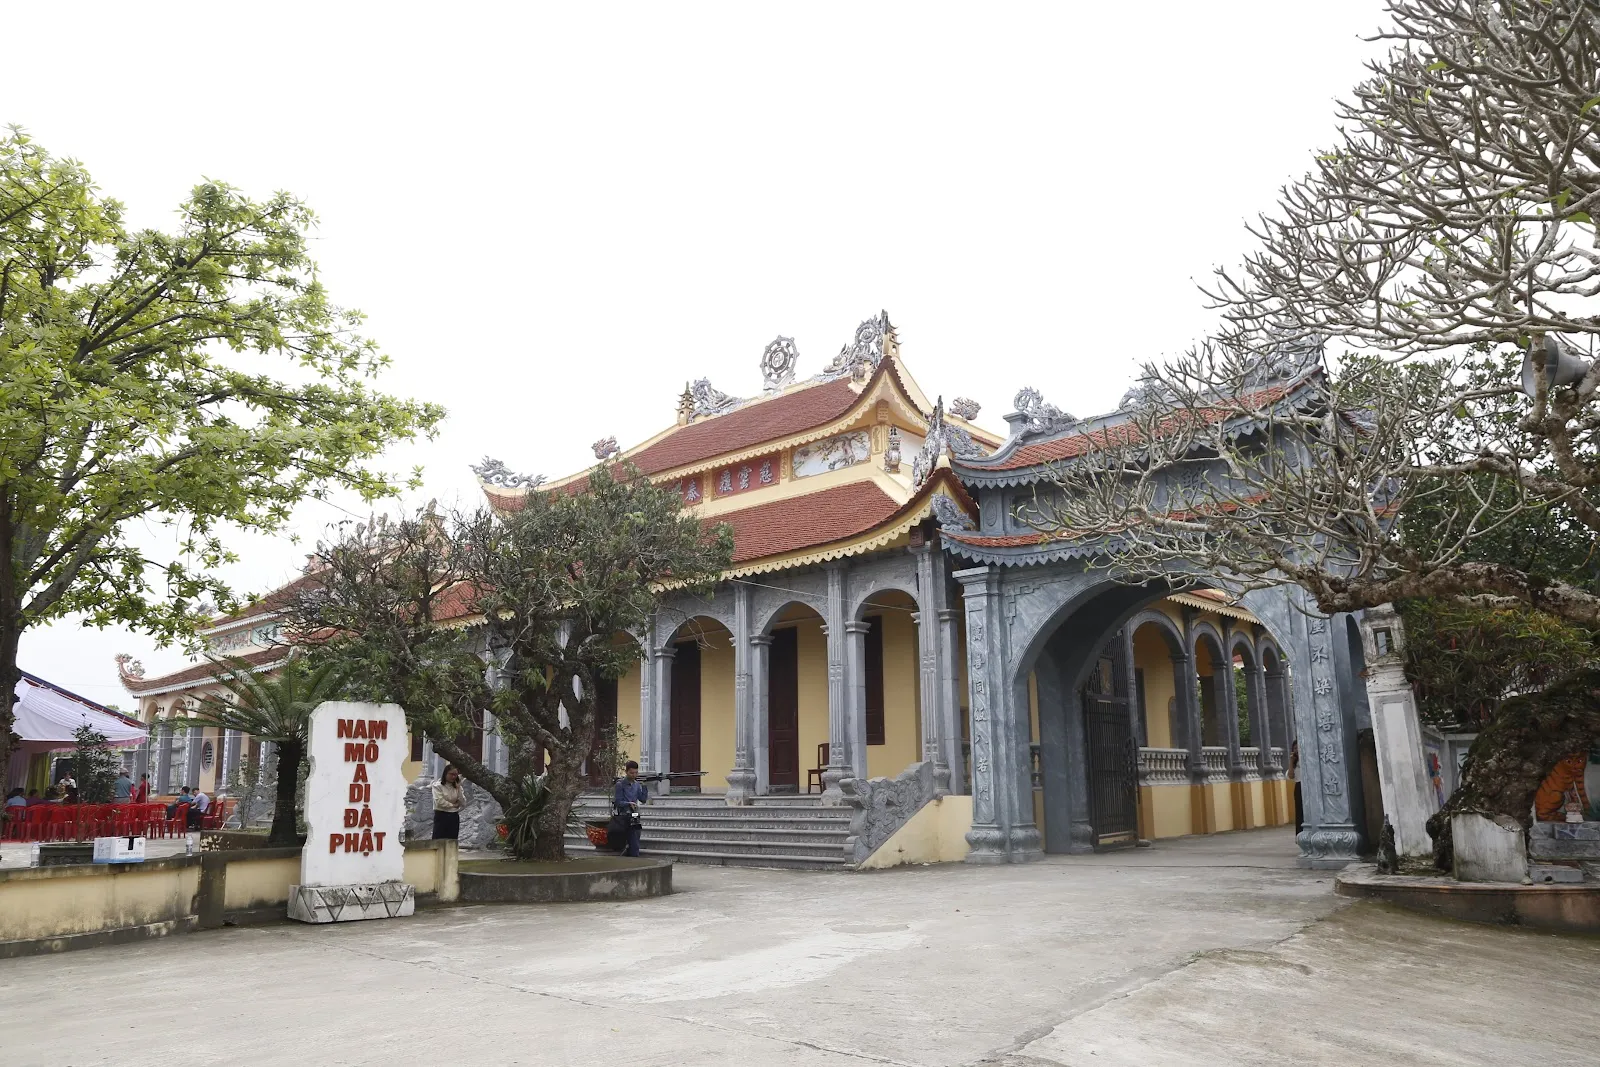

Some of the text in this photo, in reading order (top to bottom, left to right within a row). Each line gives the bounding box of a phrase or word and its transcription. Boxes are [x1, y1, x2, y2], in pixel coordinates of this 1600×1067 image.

[337, 718, 388, 740] NAM
[344, 739, 379, 763] MÔ
[353, 763, 369, 783] A
[349, 783, 371, 804] DI
[344, 804, 374, 829] ĐÀ
[329, 829, 387, 857] PHẬT
